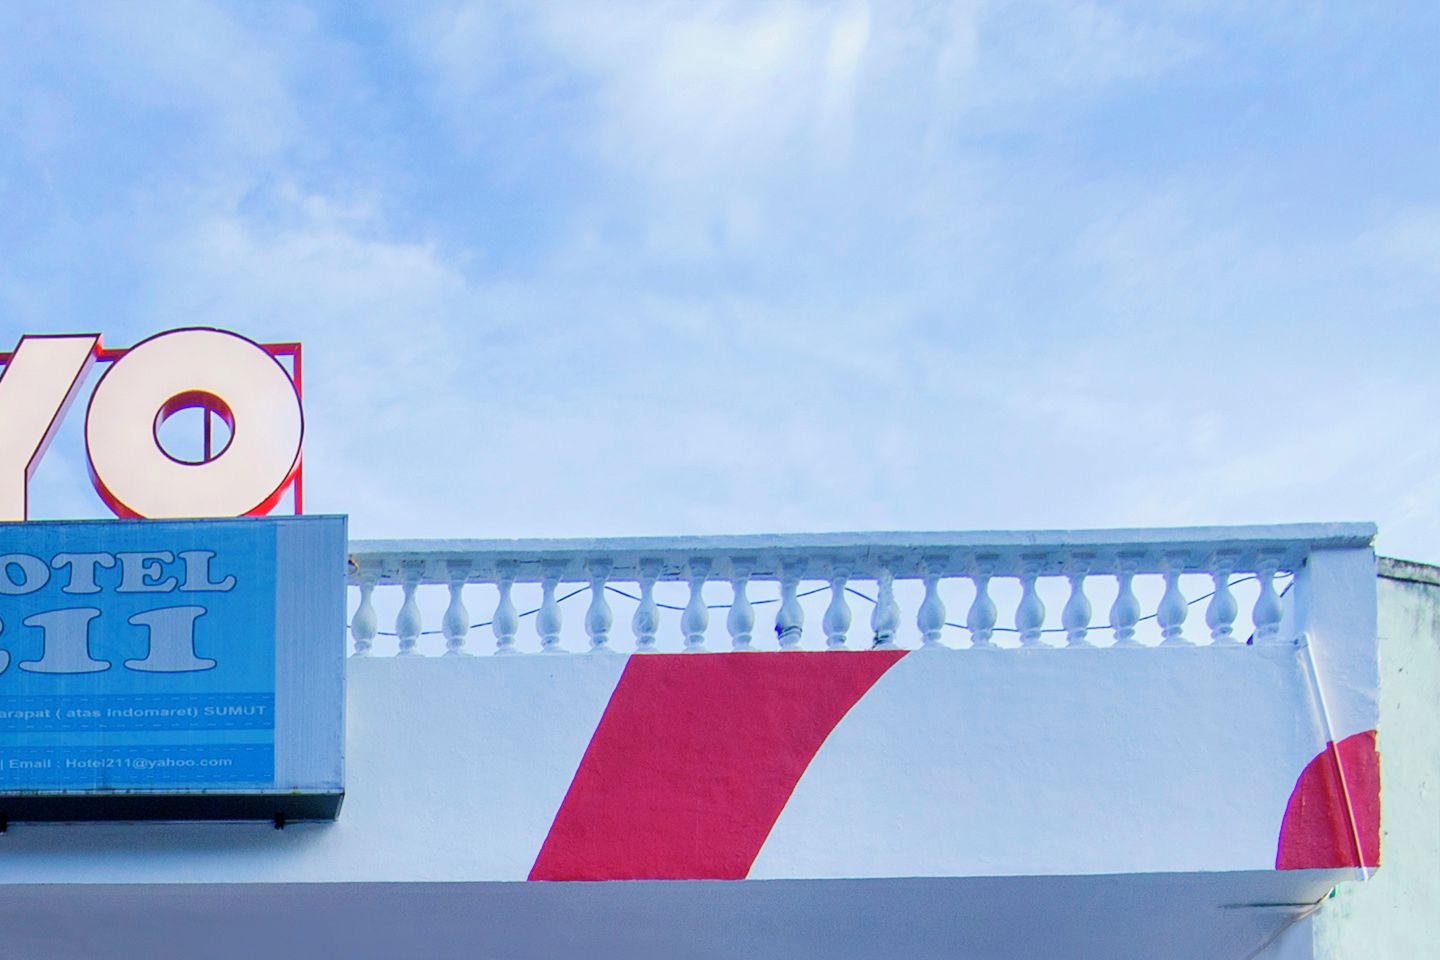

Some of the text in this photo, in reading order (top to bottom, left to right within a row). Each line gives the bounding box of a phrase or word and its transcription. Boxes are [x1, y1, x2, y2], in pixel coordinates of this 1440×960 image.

[66, 707, 101, 718] atas
[107, 705, 199, 718] Indomaret)
[204, 705, 267, 717] SUMUT
[9, 757, 52, 769] Email
[65, 756, 233, 770] Hotel211@yahoo.com
